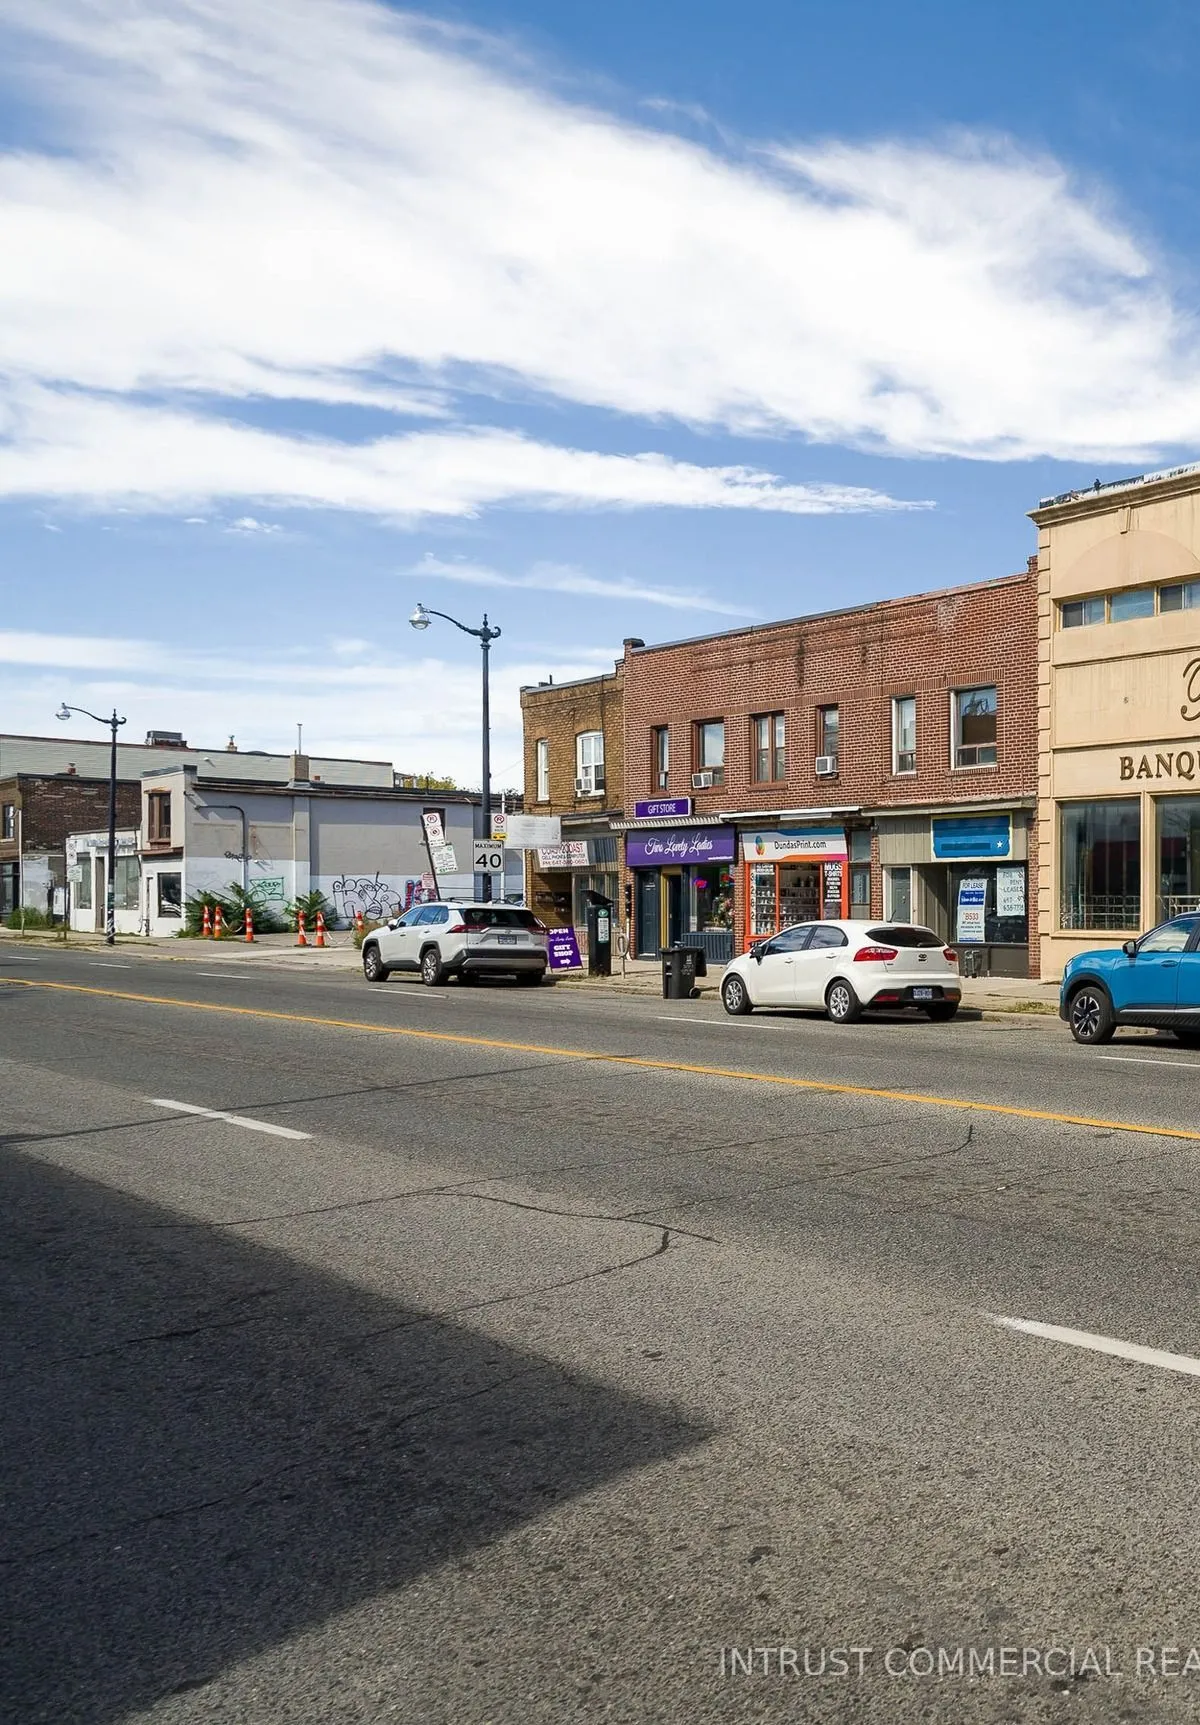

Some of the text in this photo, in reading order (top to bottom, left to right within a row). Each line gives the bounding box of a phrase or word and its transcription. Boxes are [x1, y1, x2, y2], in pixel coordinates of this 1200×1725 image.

[648, 803, 676, 814] GIFT STORE
[774, 840, 827, 850] DundasPrint.com
[475, 853, 501, 868] 40
[971, 881, 984, 889] LEASE
